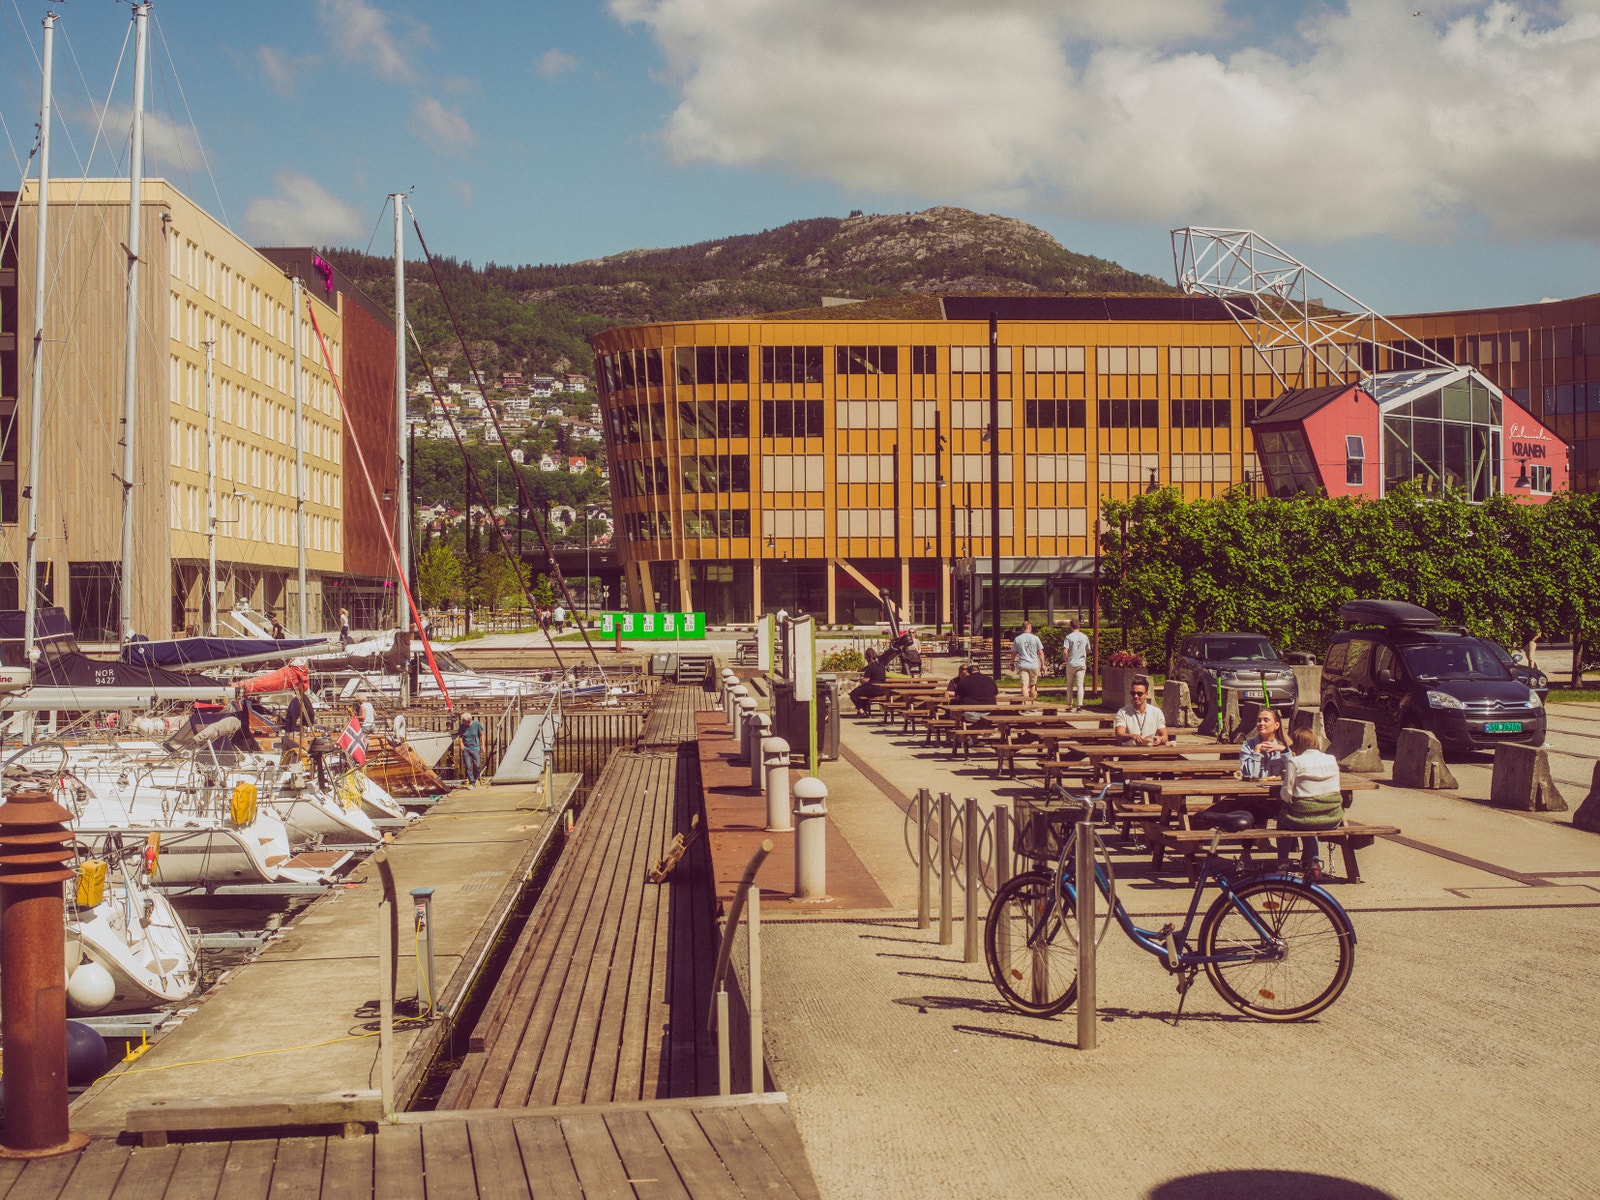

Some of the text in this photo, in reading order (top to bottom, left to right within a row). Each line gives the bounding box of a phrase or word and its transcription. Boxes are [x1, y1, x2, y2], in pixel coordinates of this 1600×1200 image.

[1511, 441, 1546, 459] KRANEN
[95, 669, 114, 677] NOR
[95, 677, 115, 685] 9427
